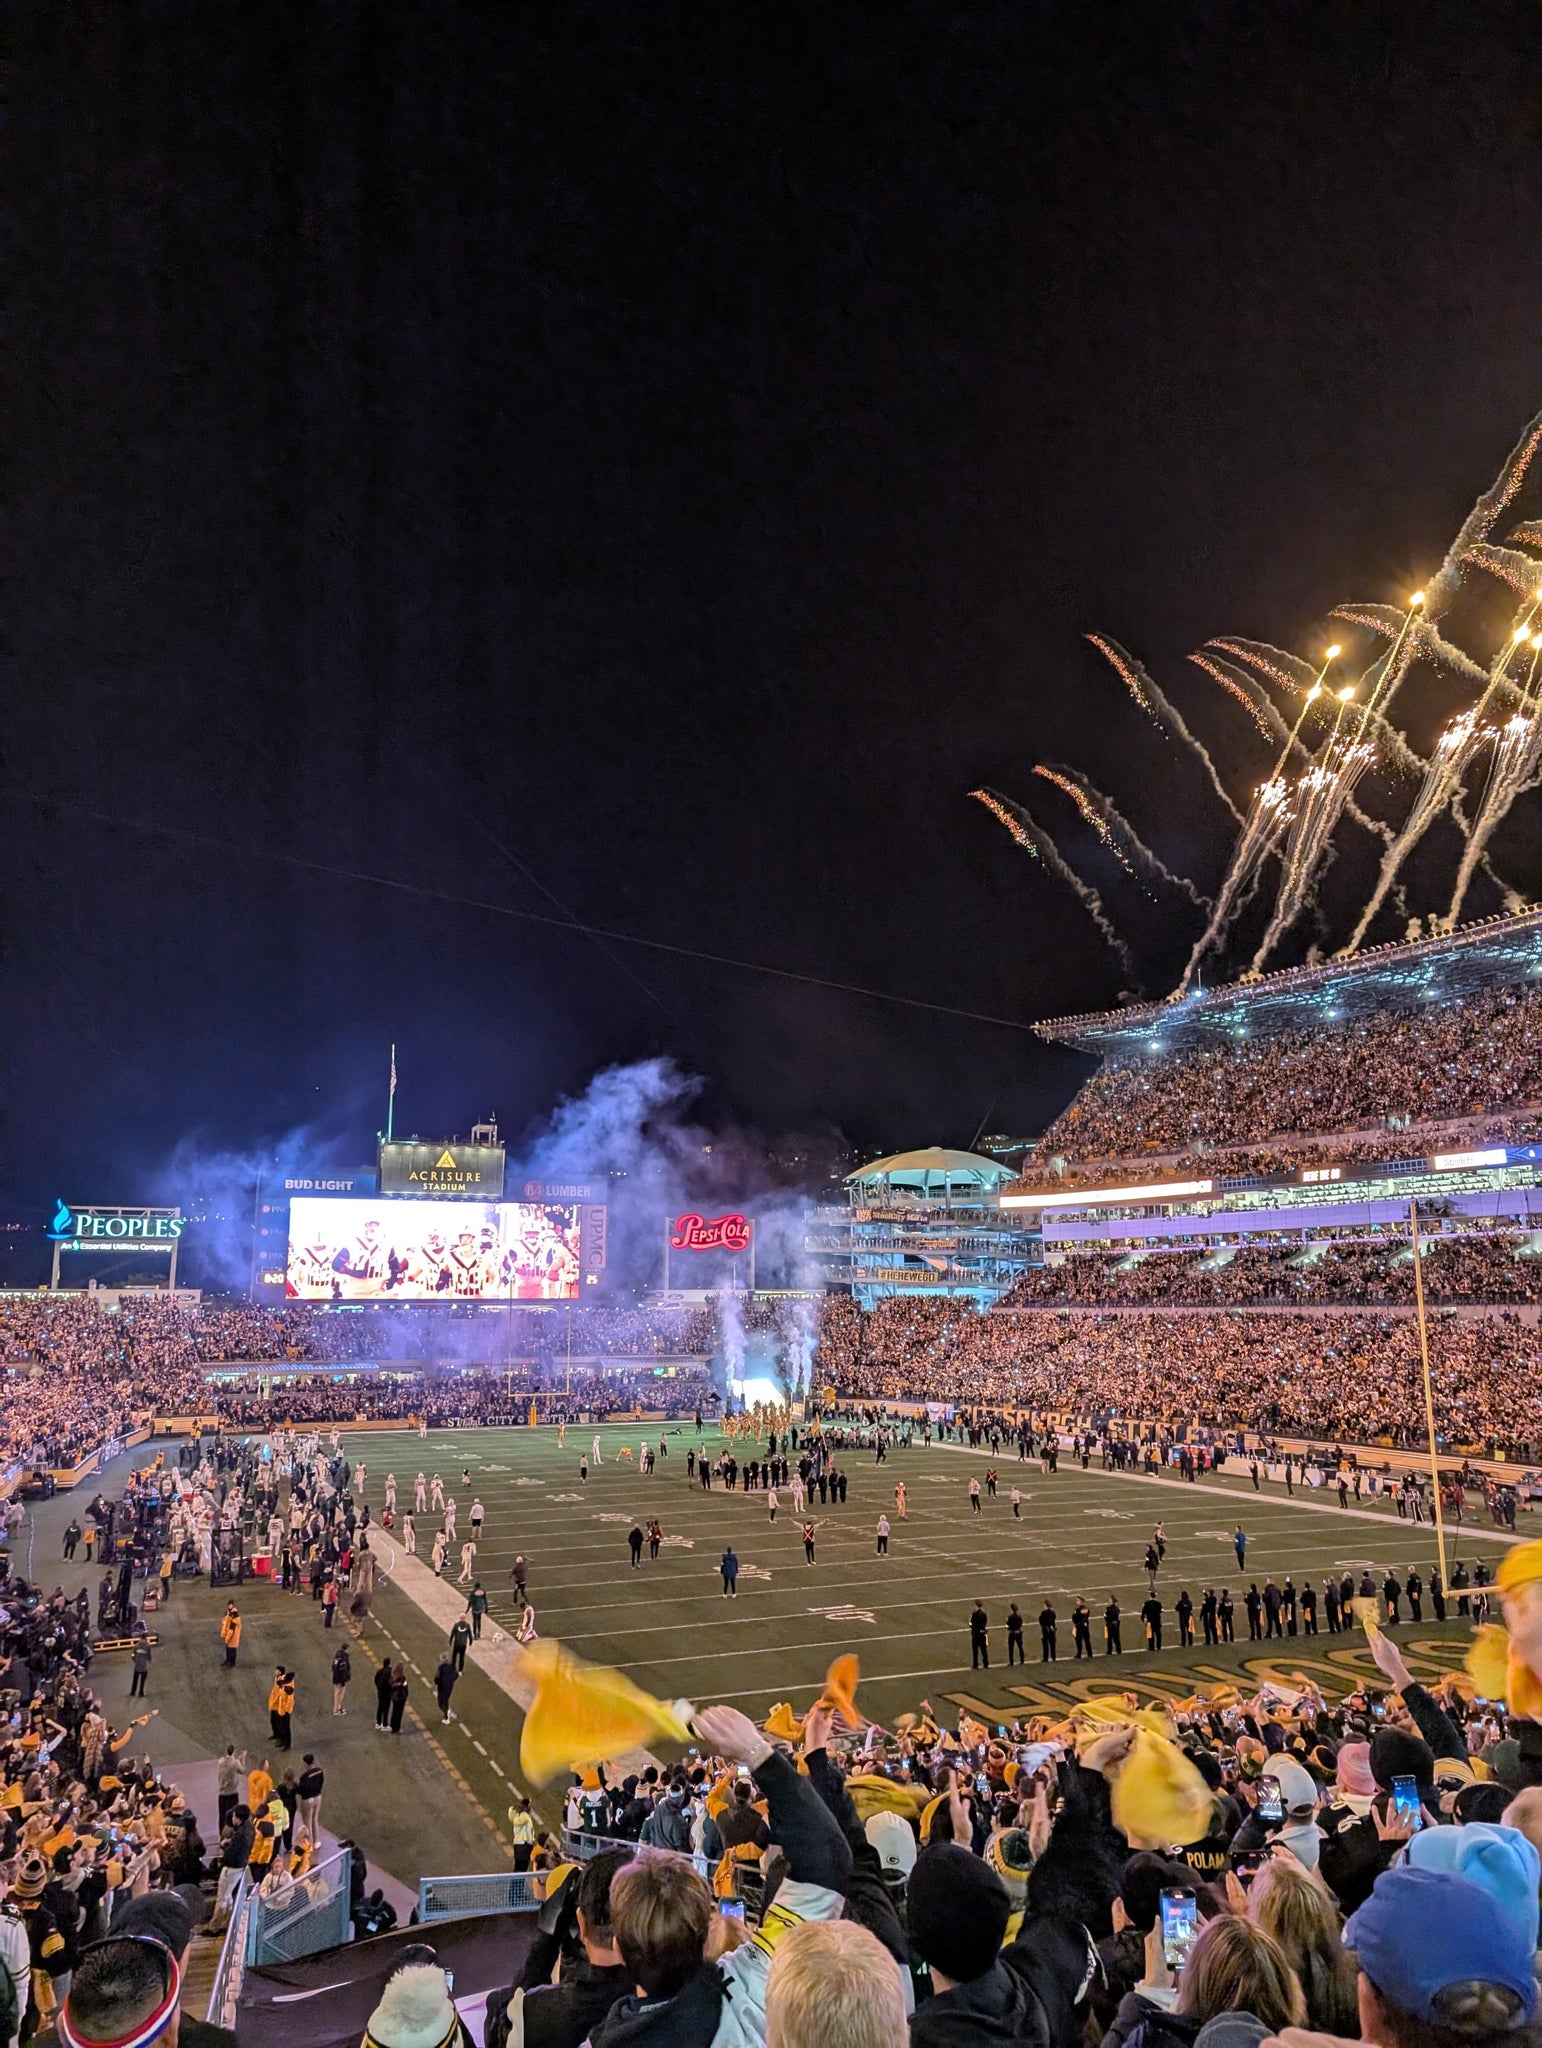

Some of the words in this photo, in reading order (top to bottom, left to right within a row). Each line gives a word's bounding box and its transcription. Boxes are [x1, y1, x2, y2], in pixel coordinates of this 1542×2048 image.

[409, 1171, 481, 1182] ACRISURE
[284, 1179, 313, 1190] BUD
[314, 1179, 354, 1191] LIGHT
[422, 1182, 467, 1191] STADIUM
[545, 1185, 592, 1197] LUMBER
[75, 1214, 183, 1239] PEOPLES
[589, 1208, 605, 1266] UPMC
[60, 1242, 72, 1250] An
[80, 1242, 112, 1251] Essential
[112, 1243, 140, 1251] Utilities
[140, 1243, 173, 1253] Company
[879, 1269, 935, 1283] #HEREWEGO
[486, 1415, 515, 1427] CITY
[590, 1810, 598, 1828] 1
